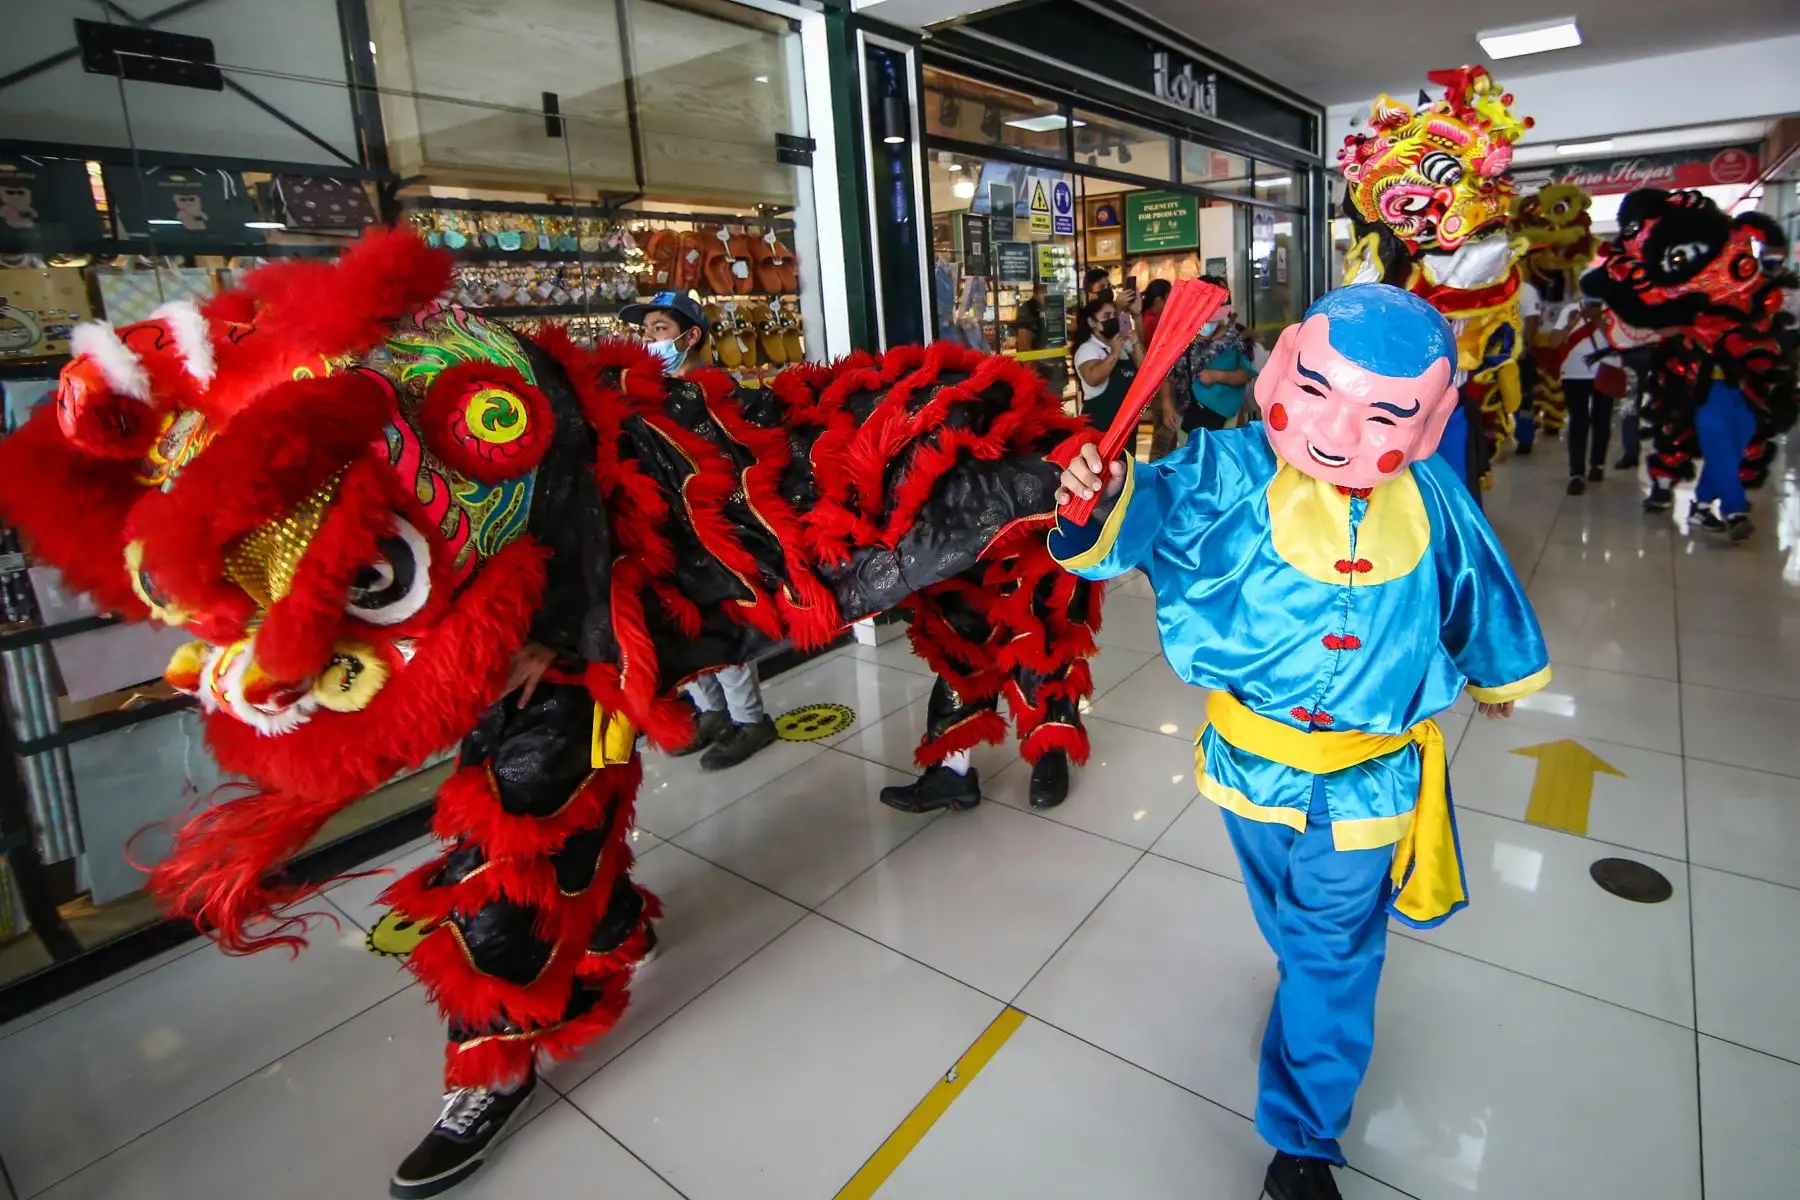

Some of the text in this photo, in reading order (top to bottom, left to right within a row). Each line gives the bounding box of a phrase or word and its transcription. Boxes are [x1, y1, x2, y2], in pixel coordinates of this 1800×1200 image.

[1561, 158, 1674, 190] Euro Hogar
[1138, 209, 1187, 221] FOR PRODUCTS
